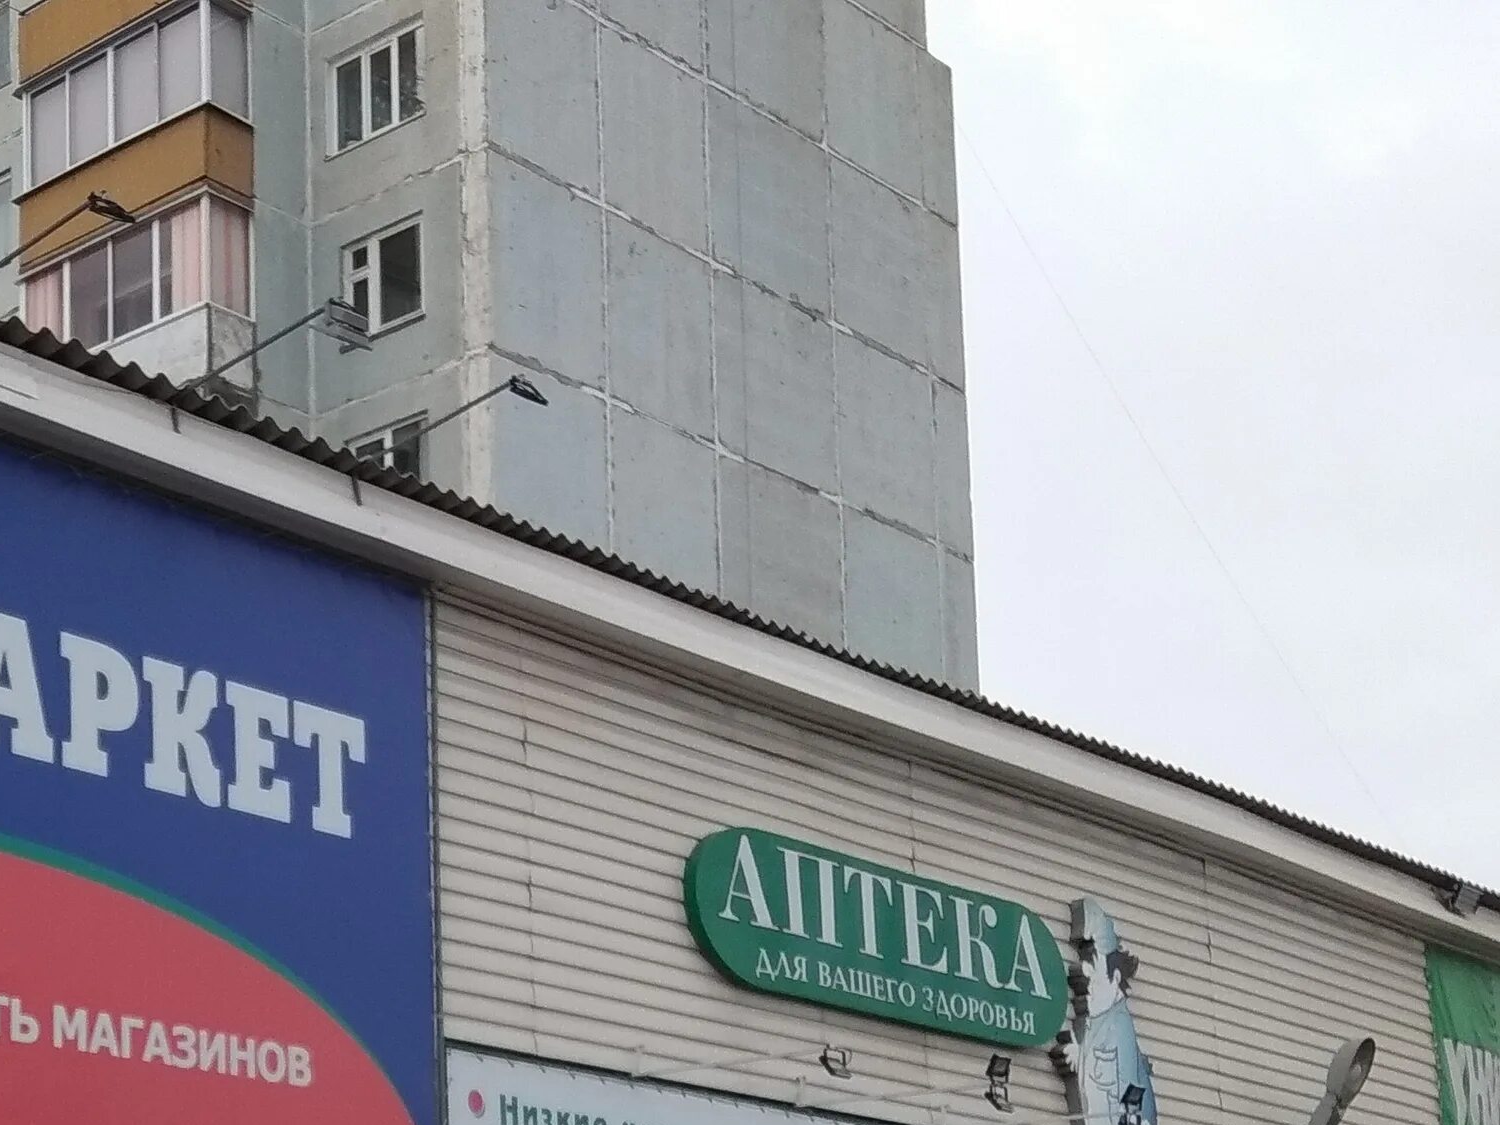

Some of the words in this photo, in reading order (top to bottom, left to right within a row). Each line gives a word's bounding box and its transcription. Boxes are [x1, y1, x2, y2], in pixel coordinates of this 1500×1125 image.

[718, 833, 1053, 1000] АПТЕКА
[755, 948, 808, 984] ДЛЯ
[817, 962, 916, 1008] ВАШЕГО
[921, 986, 1038, 1036] ЗДОРОВЬЯ
[53, 1004, 313, 1087] МАГАЗИНОВ
